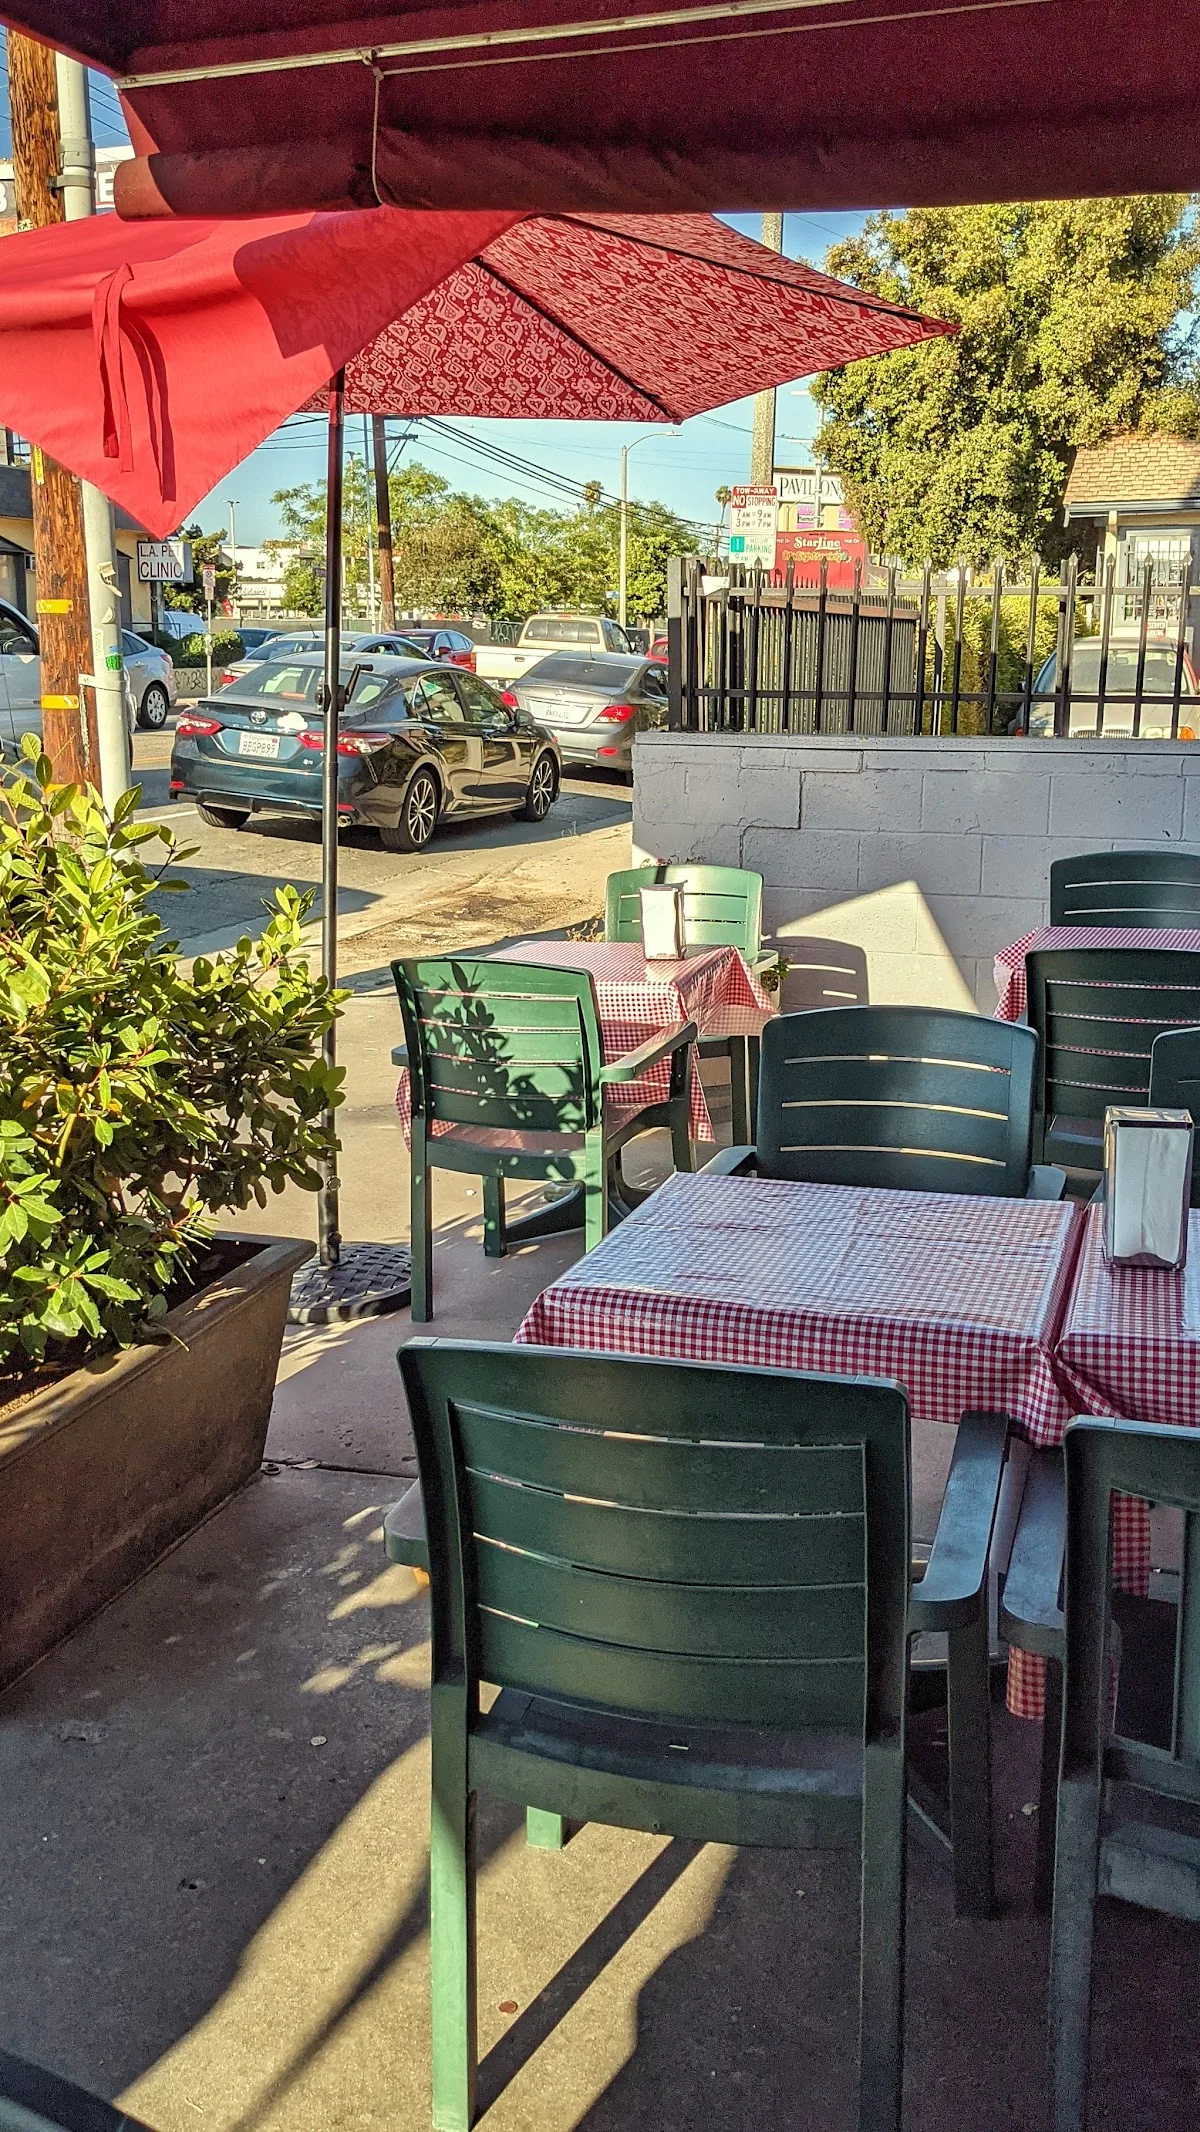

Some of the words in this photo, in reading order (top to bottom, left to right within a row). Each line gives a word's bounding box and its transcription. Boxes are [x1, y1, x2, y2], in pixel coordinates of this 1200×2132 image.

[736, 487, 775, 495] TOW-AWAY
[780, 477, 844, 500] PAVILONS
[732, 495, 746, 506] NO
[747, 496, 775, 507] STOPPING
[140, 545, 159, 557] L.A.
[746, 544, 772, 553] PARKING
[140, 561, 183, 578] CLINIC
